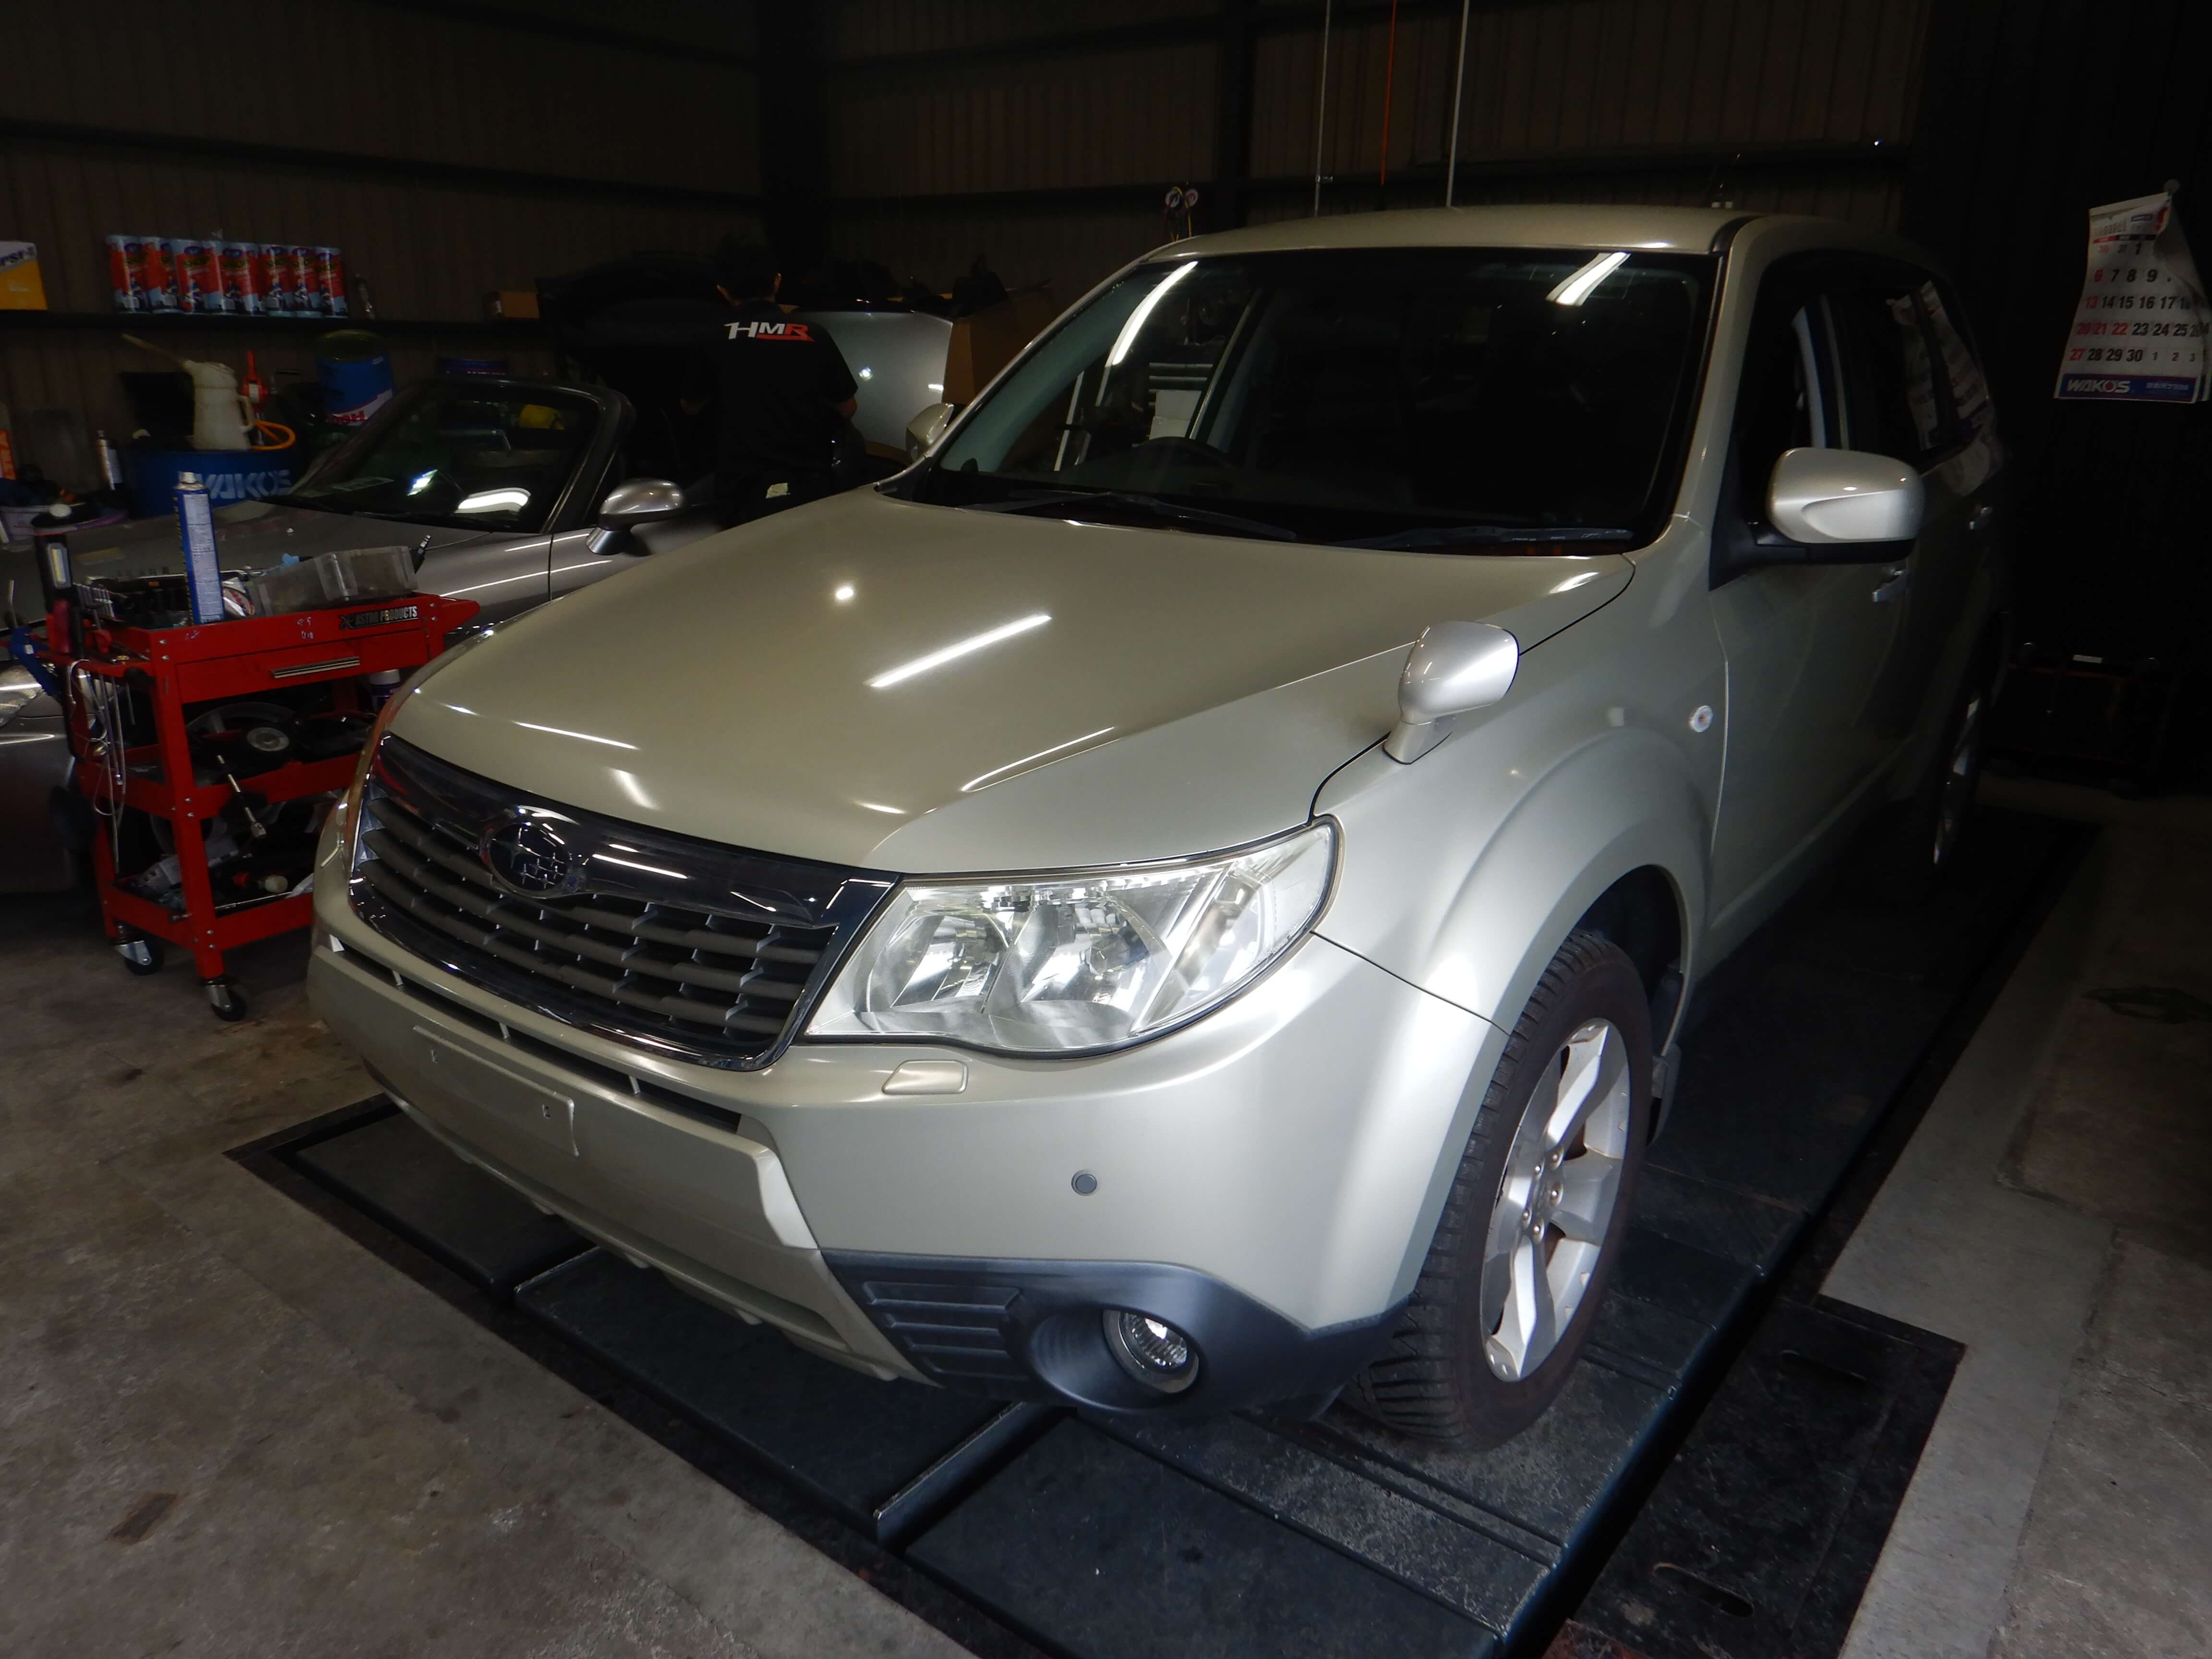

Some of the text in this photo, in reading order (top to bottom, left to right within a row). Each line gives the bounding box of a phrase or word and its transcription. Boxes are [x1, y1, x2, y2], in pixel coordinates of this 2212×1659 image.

[2135, 242, 2141, 255] 1
[2112, 269, 2120, 282] 7
[2127, 269, 2137, 282] 8
[2147, 269, 2157, 282] 9
[2102, 296, 2115, 309] 14
[2119, 296, 2134, 309] 15
[2140, 296, 2155, 309] 16
[2161, 296, 2176, 309] 17
[723, 321, 815, 342] HMR
[2077, 323, 2090, 335] 20
[2093, 323, 2107, 335] 21
[2112, 323, 2128, 335] 22
[2131, 323, 2148, 336] 23
[2152, 323, 2170, 336] 24
[2173, 323, 2188, 336] 25
[2069, 349, 2196, 362] 27 28 29 30 1 2 3
